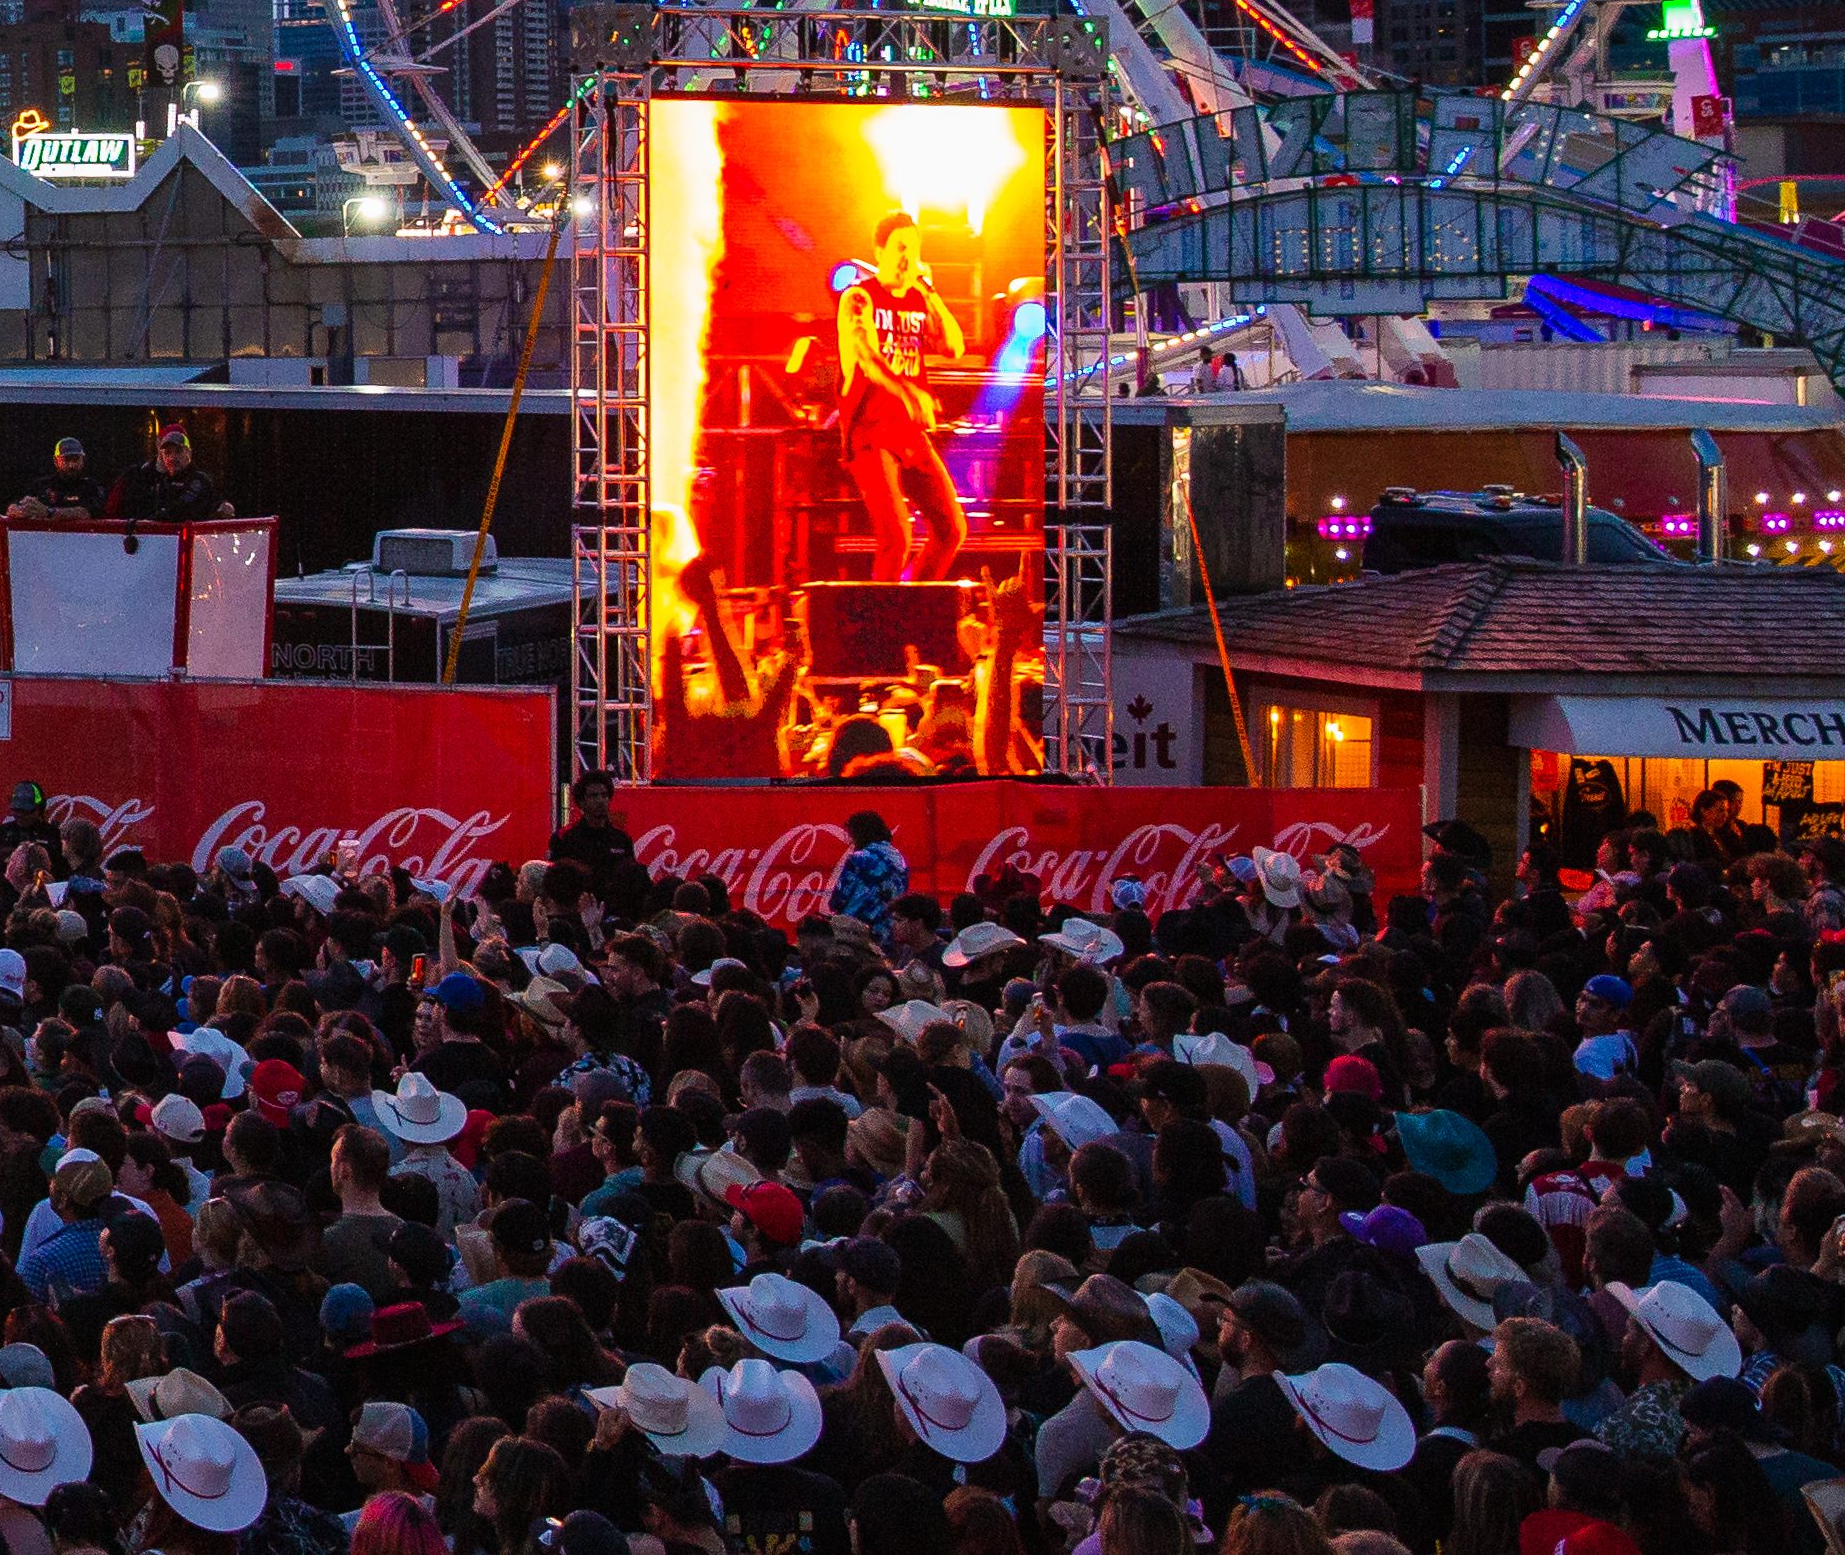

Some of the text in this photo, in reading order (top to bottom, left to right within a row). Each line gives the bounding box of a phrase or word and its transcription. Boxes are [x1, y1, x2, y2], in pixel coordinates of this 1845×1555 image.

[20, 139, 125, 171] OUTLAW
[271, 642, 375, 672] NORTH
[1665, 706, 1845, 746] MERCH
